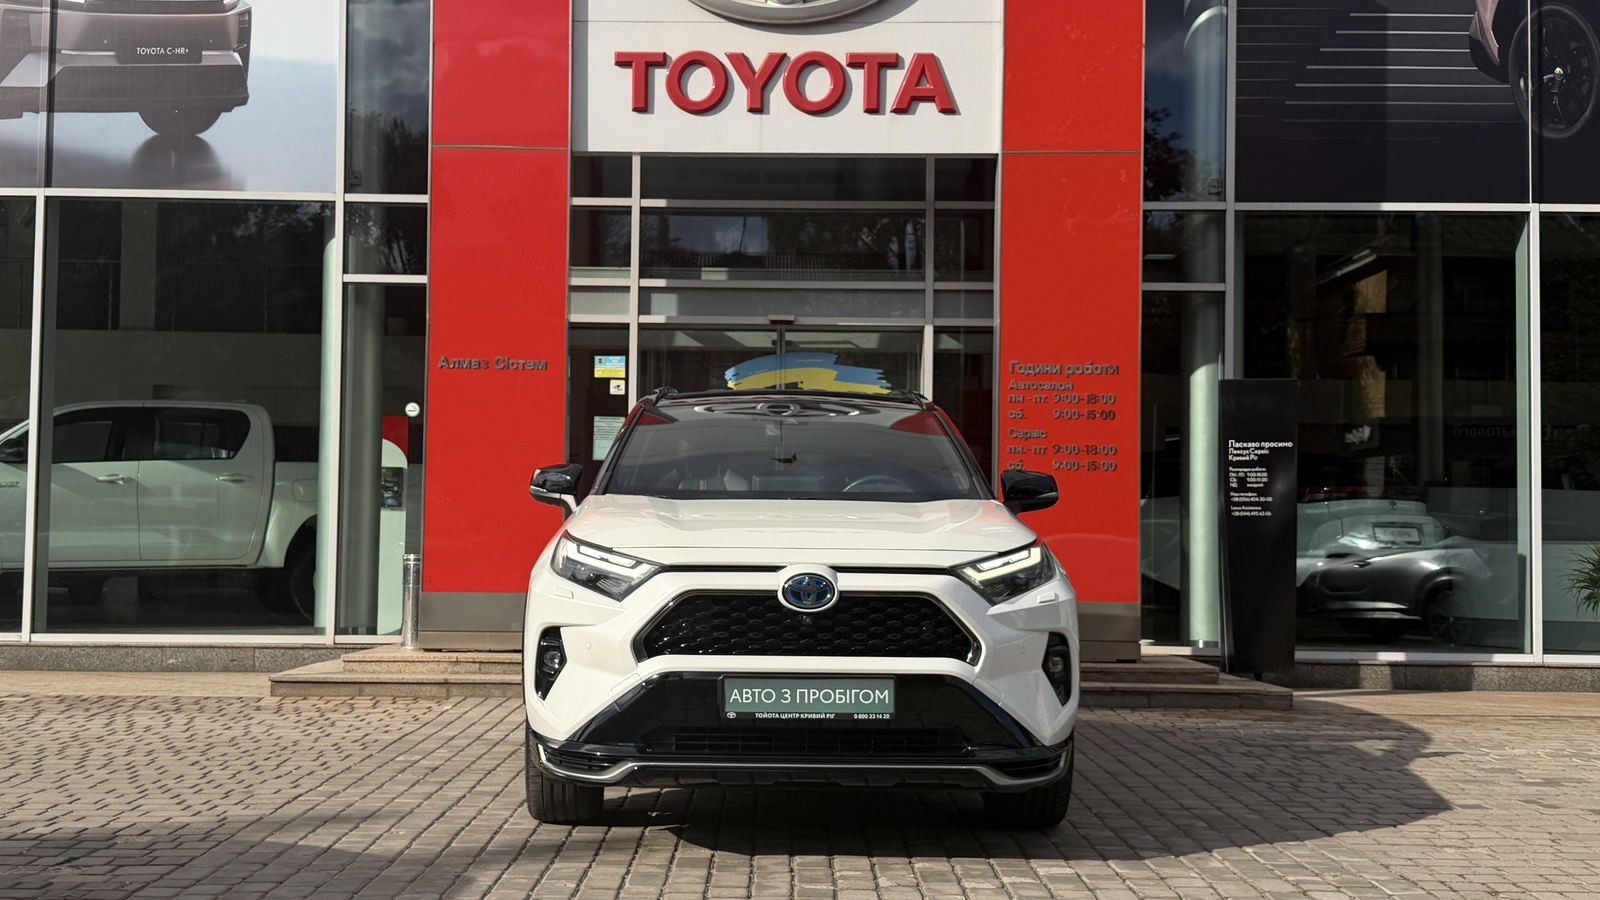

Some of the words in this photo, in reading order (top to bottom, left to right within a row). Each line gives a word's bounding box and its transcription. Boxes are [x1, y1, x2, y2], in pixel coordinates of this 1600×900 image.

[136, 47, 165, 55] TOYOTA
[166, 47, 189, 55] C-HR+
[614, 50, 957, 114] TOYOTA
[438, 355, 489, 370] Алмаз
[493, 356, 548, 371] Сістем
[1009, 361, 1062, 376] Години
[1065, 362, 1119, 377] роботи
[1008, 379, 1074, 391] Автосалон
[1053, 393, 1116, 404] 9:00-18:00
[1053, 409, 1116, 420] 9:00-15:00
[1008, 427, 1048, 440] Сервіс
[1052, 444, 1117, 455] 9:00-18:00
[1228, 440, 1260, 448] Ласкаво
[1052, 460, 1117, 471] 9:00-15:00
[729, 688, 776, 703] АВТО
[796, 689, 889, 704] ПРОБІГОМ
